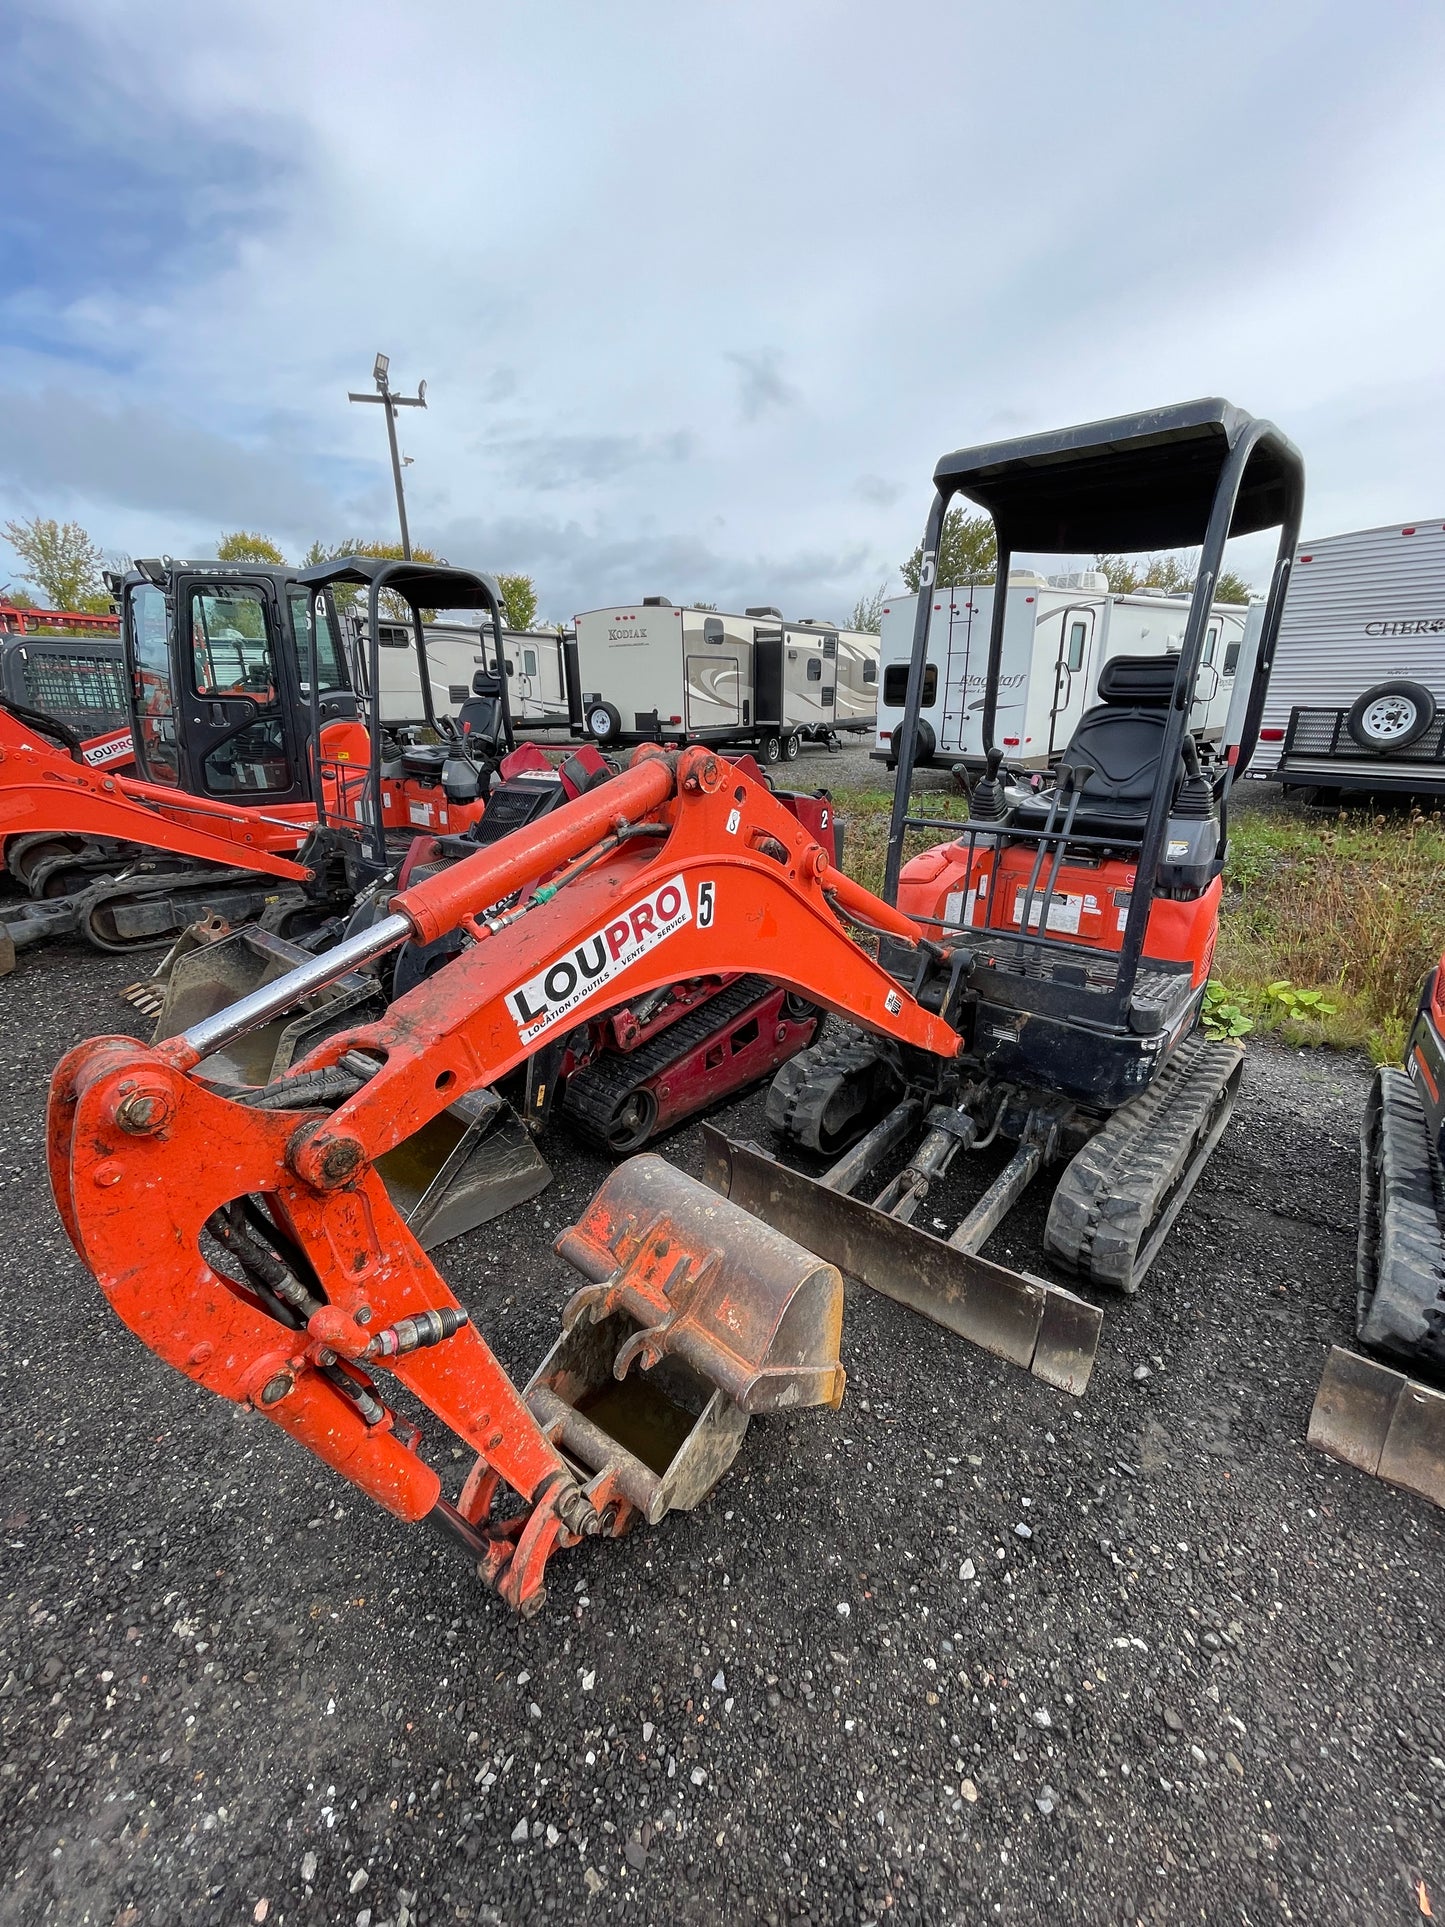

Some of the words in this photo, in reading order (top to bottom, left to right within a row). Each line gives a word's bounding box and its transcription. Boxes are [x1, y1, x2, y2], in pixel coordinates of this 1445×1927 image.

[920, 550, 935, 587] 5
[316, 597, 325, 615] 4
[608, 629, 648, 640] KODIAK
[20, 648, 27, 659] 1
[821, 809, 828, 829] 2
[700, 882, 713, 927] 5
[514, 885, 681, 1024] LOUPRO
[572, 971, 610, 1004] D'OUTILS
[621, 944, 645, 966] VENTE
[657, 913, 687, 939] SERVICE
